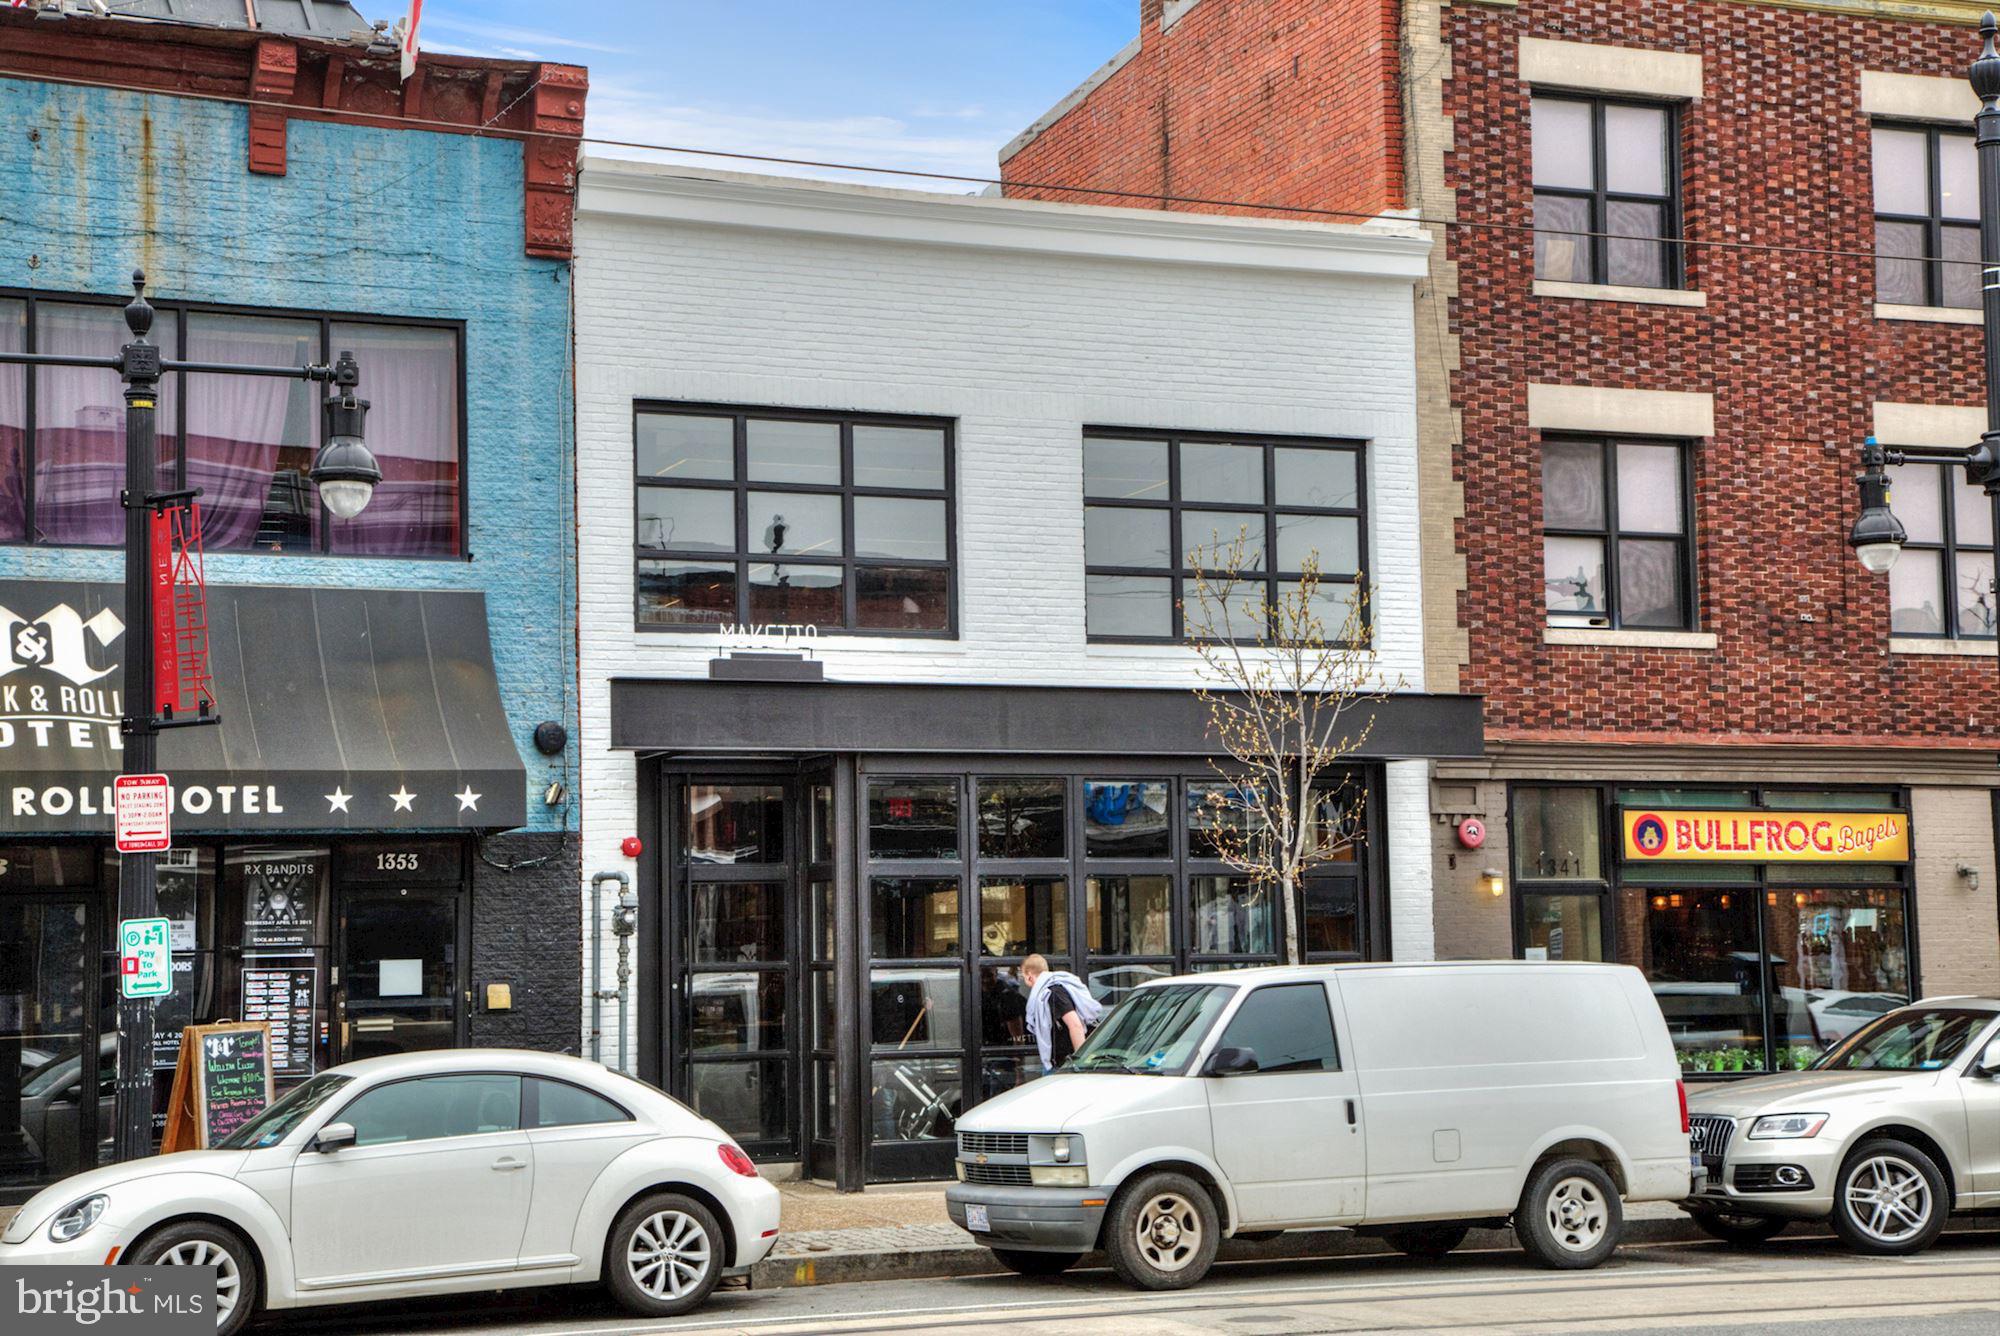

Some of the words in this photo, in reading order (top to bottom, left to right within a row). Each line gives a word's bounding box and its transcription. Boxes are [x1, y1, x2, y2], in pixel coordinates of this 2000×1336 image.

[30, 685, 49, 712] &
[60, 686, 124, 717] ROLL
[12, 786, 116, 815] ROLL
[120, 792, 131, 801] NO
[133, 791, 163, 800] PARKING
[1675, 819, 1834, 853] BULLFROG
[1837, 816, 1899, 853] Bagels
[376, 853, 420, 870] 1353
[1535, 858, 1580, 877] 1341
[244, 864, 261, 875] RX
[265, 863, 314, 875] BANDITS
[137, 950, 155, 959] Pay
[142, 961, 153, 969] To
[137, 970, 158, 979] Park
